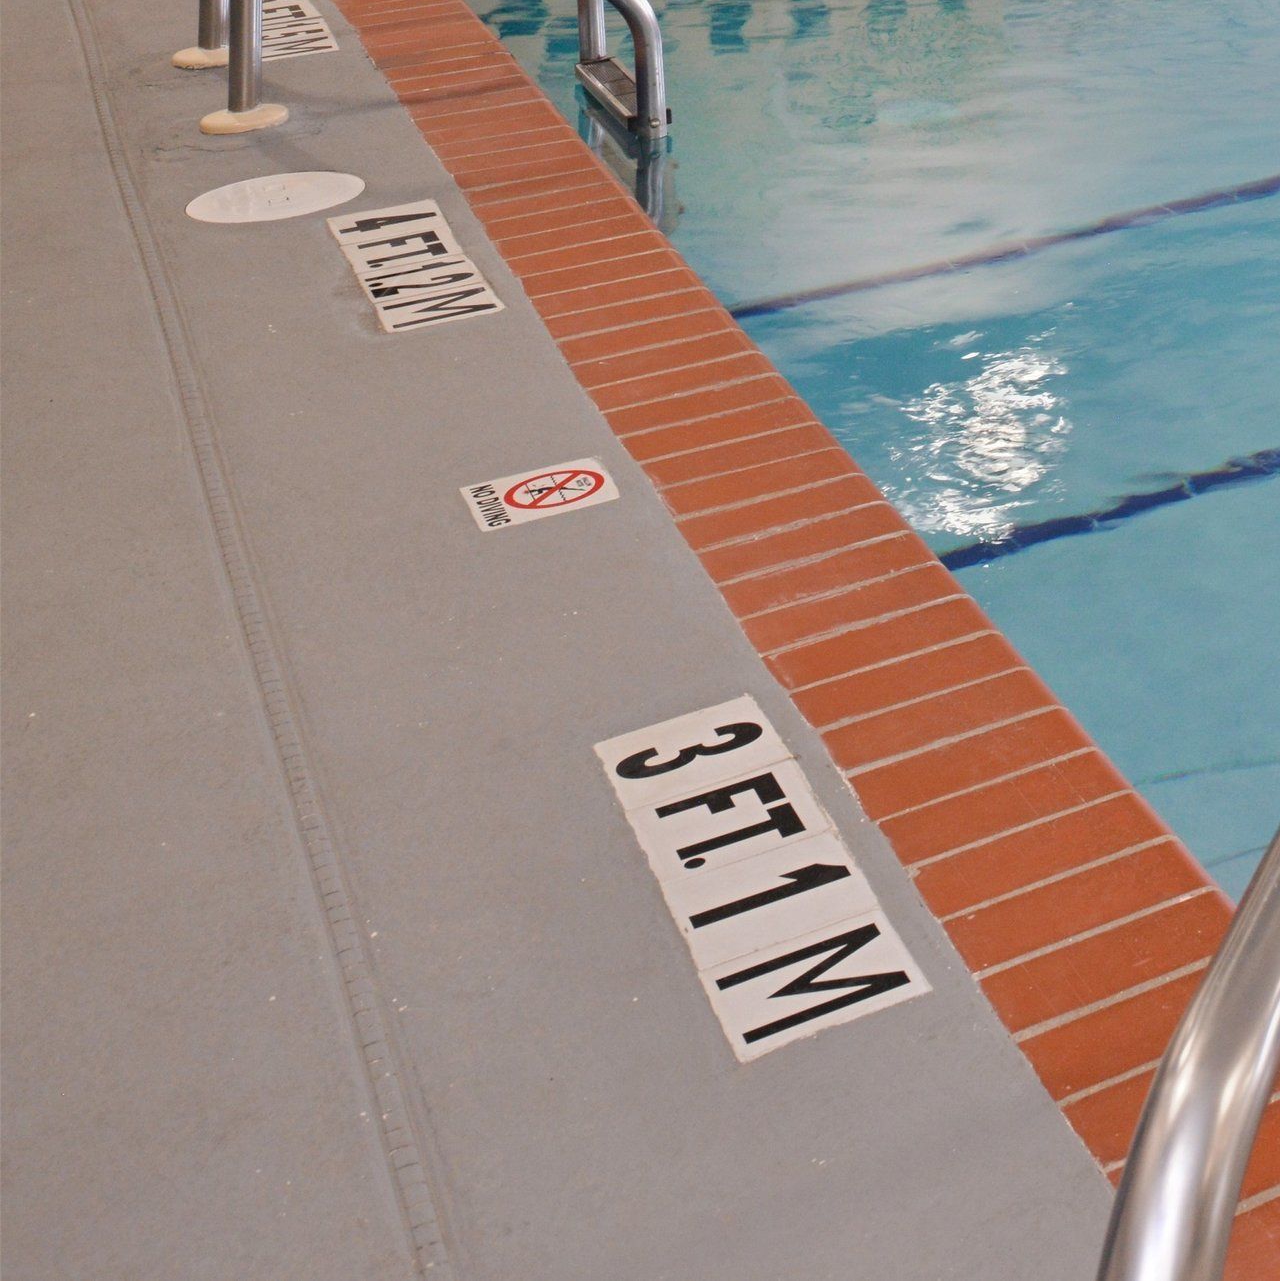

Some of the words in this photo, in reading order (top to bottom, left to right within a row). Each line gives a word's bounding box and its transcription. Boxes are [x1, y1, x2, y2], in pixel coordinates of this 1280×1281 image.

[339, 212, 437, 234] 4
[383, 287, 497, 328] M
[470, 484, 495, 498] NO
[476, 497, 511, 527] DIVING
[616, 722, 763, 779] 3
[716, 922, 911, 1044] M
